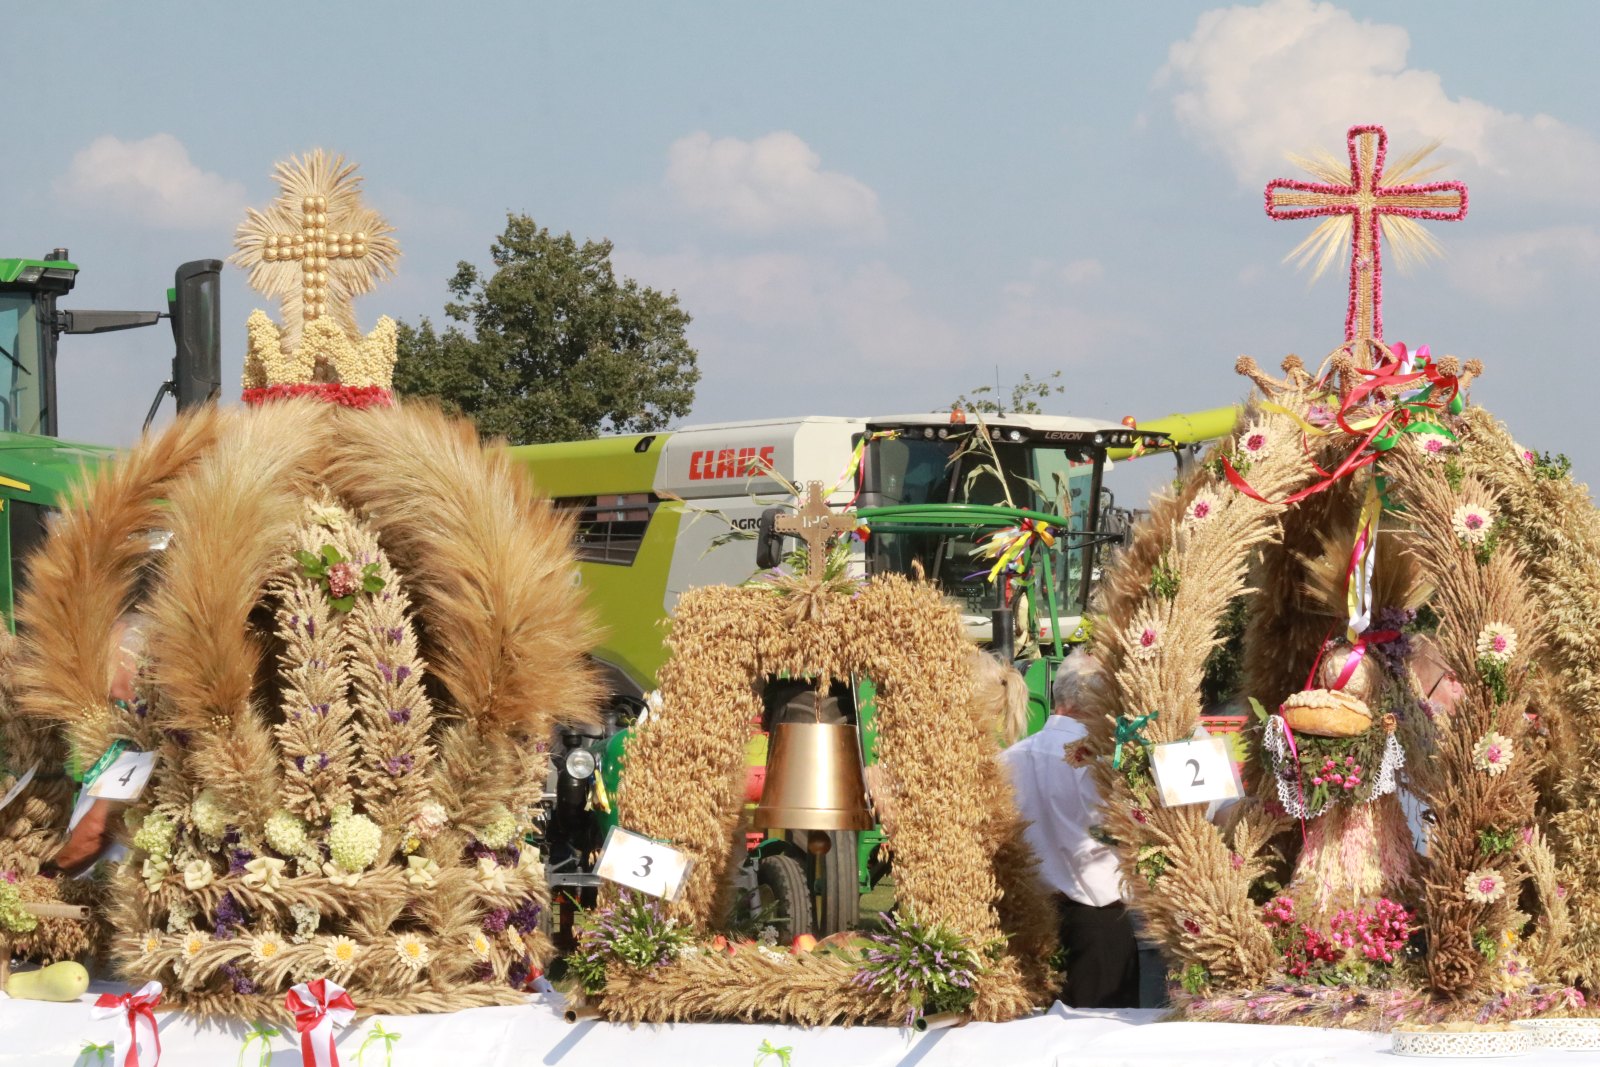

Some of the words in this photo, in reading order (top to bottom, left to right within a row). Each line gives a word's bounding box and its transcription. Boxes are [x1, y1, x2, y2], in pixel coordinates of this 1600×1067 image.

[1044, 431, 1084, 440] LEXION
[688, 446, 775, 480] CLAAS
[118, 765, 137, 787] 4
[1185, 758, 1205, 787] 2
[632, 855, 654, 878] 3
